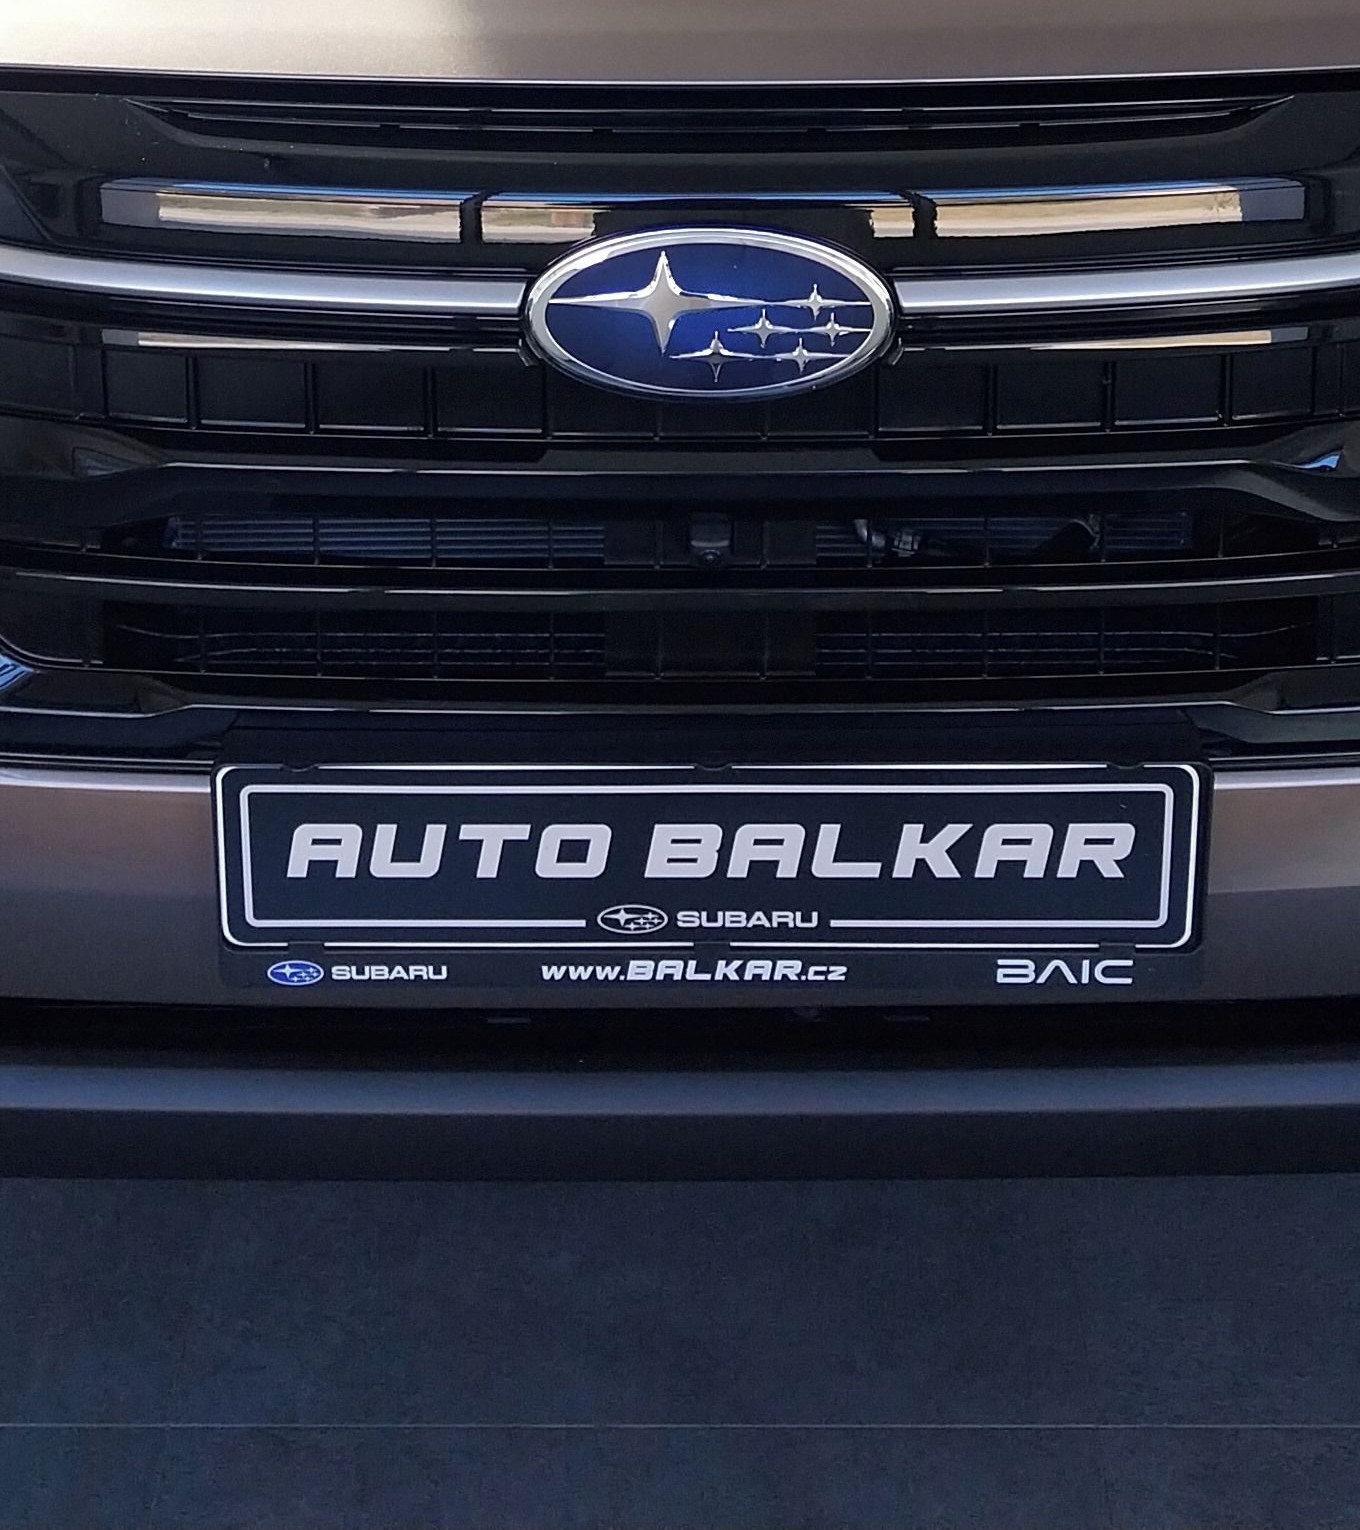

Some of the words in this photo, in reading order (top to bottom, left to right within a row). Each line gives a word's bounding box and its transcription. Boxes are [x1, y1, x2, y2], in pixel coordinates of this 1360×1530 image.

[286, 823, 612, 878] AUTO
[644, 822, 1136, 878] BALKAR
[676, 910, 818, 928] SUBARU
[331, 965, 448, 981] SUBARU
[541, 959, 848, 981] www.BALKAR.cz
[996, 958, 1134, 984] BAIC
